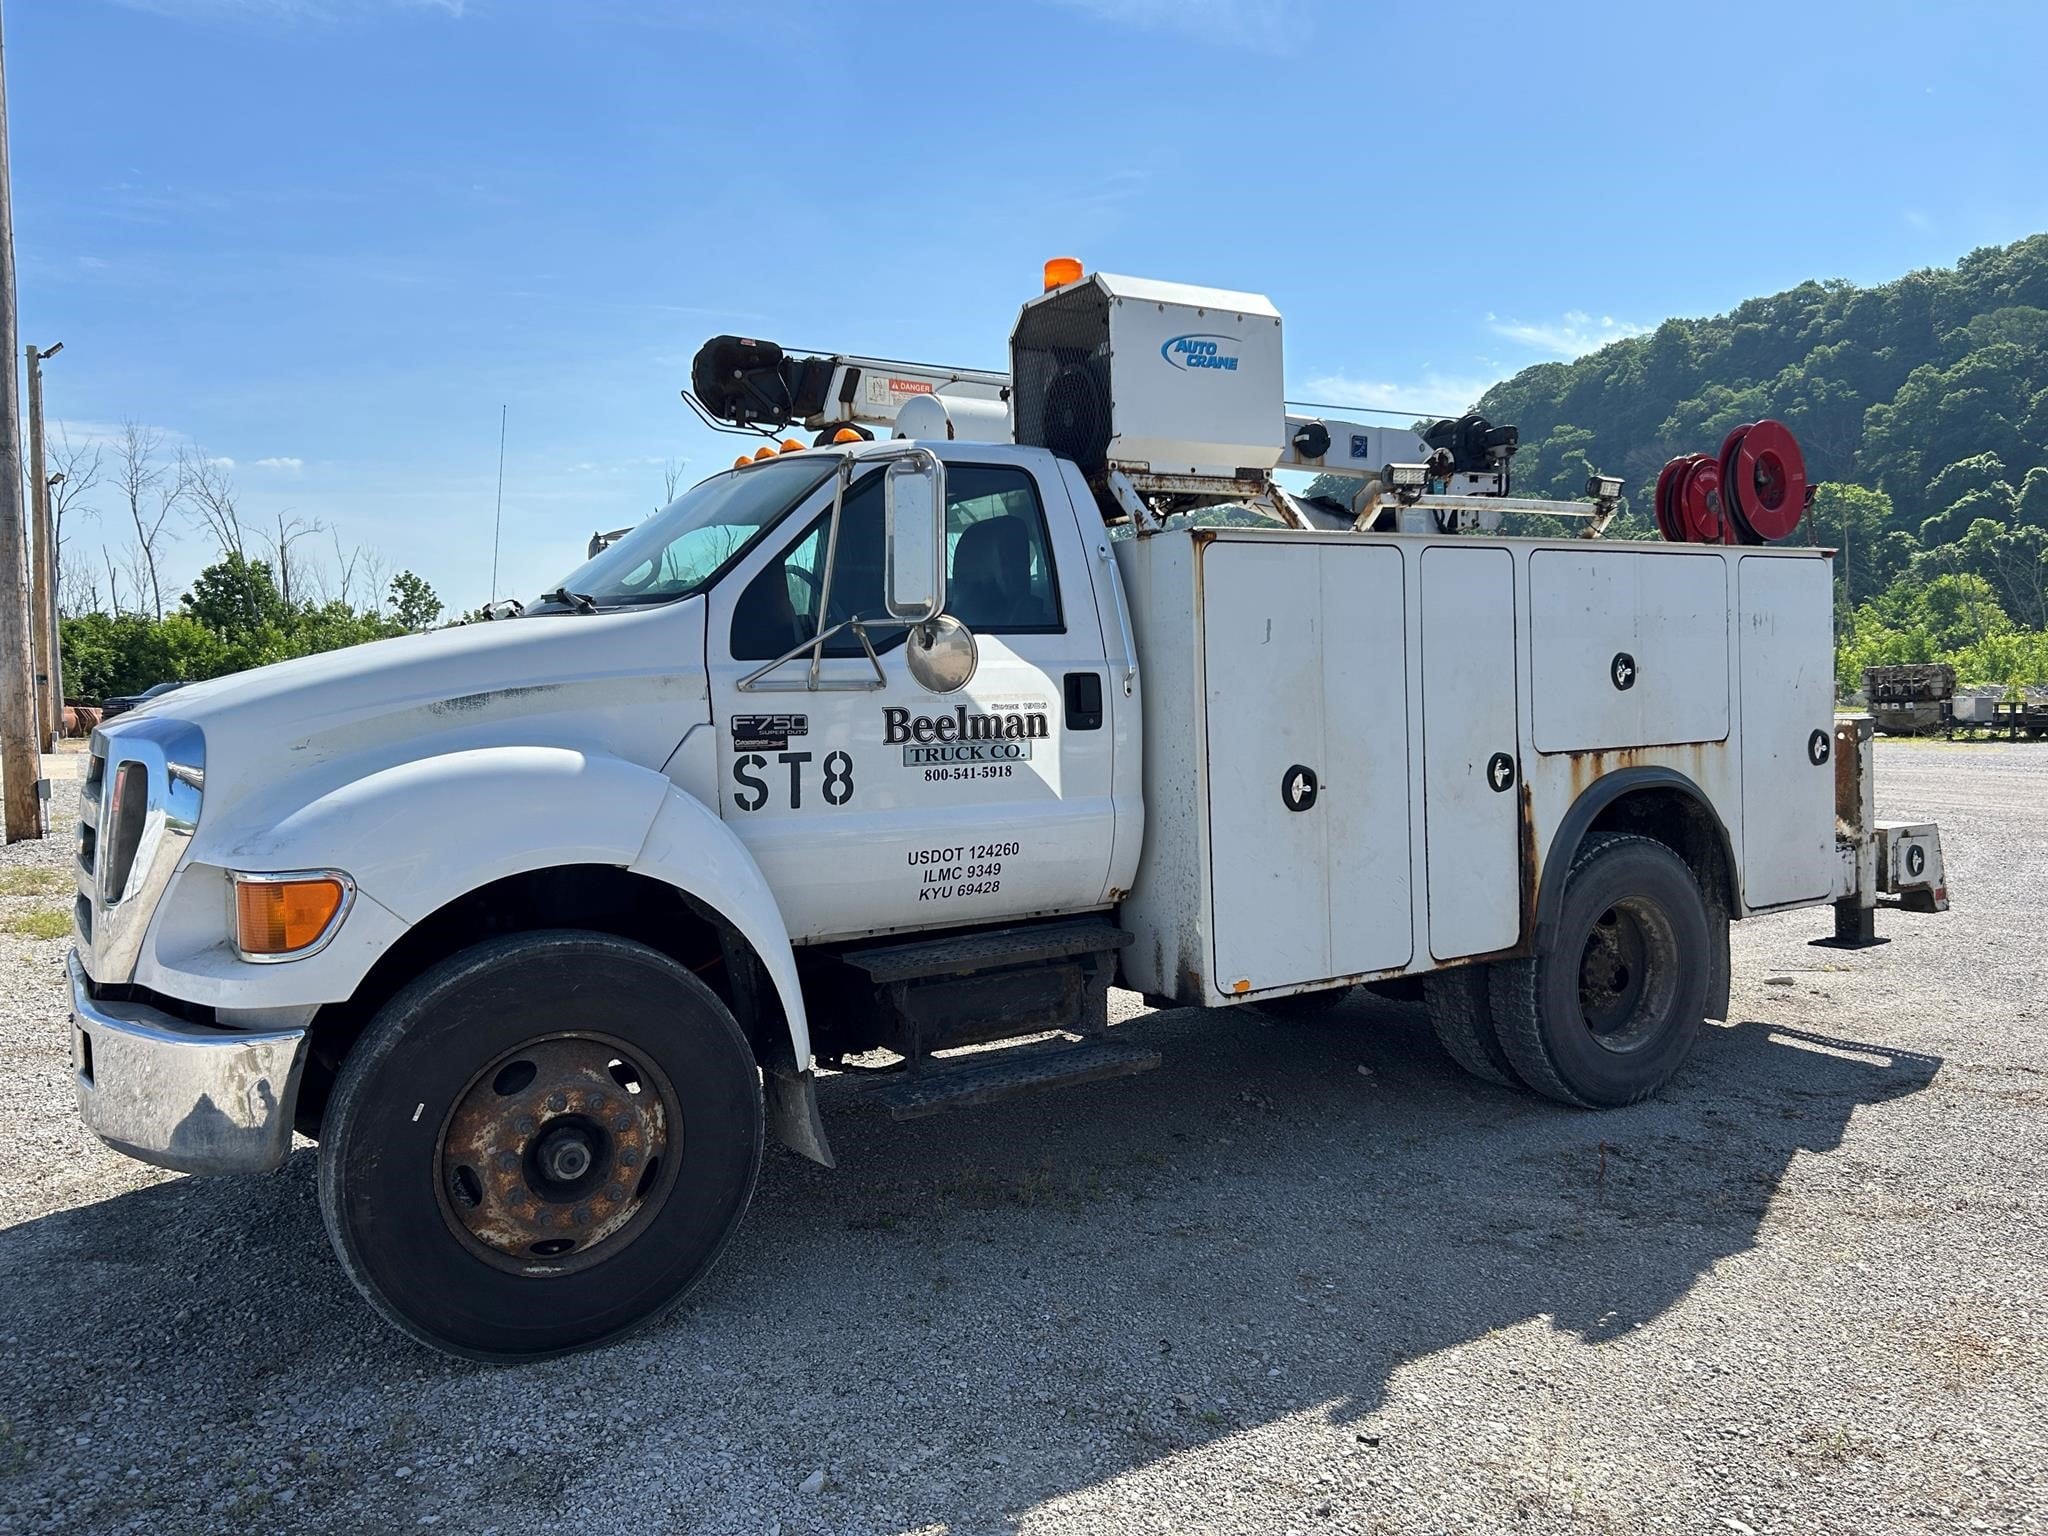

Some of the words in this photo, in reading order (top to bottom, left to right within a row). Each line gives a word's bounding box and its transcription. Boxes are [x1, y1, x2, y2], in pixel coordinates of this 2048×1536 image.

[1174, 340, 1217, 355] AUTO
[1187, 355, 1238, 370] CRANE
[900, 383, 930, 392] DANGER
[882, 704, 1049, 745] Beelman
[910, 745, 984, 763] TRUCK
[991, 744, 1025, 758] CO.
[733, 751, 854, 811] ST8
[925, 765, 1012, 781] 800-541-5918
[908, 848, 964, 865] USDOT
[969, 842, 1020, 859] 124260
[923, 867, 962, 883] ILMC
[967, 863, 1002, 878] 9349
[919, 886, 953, 901] KYU
[957, 881, 1000, 897] 69428
